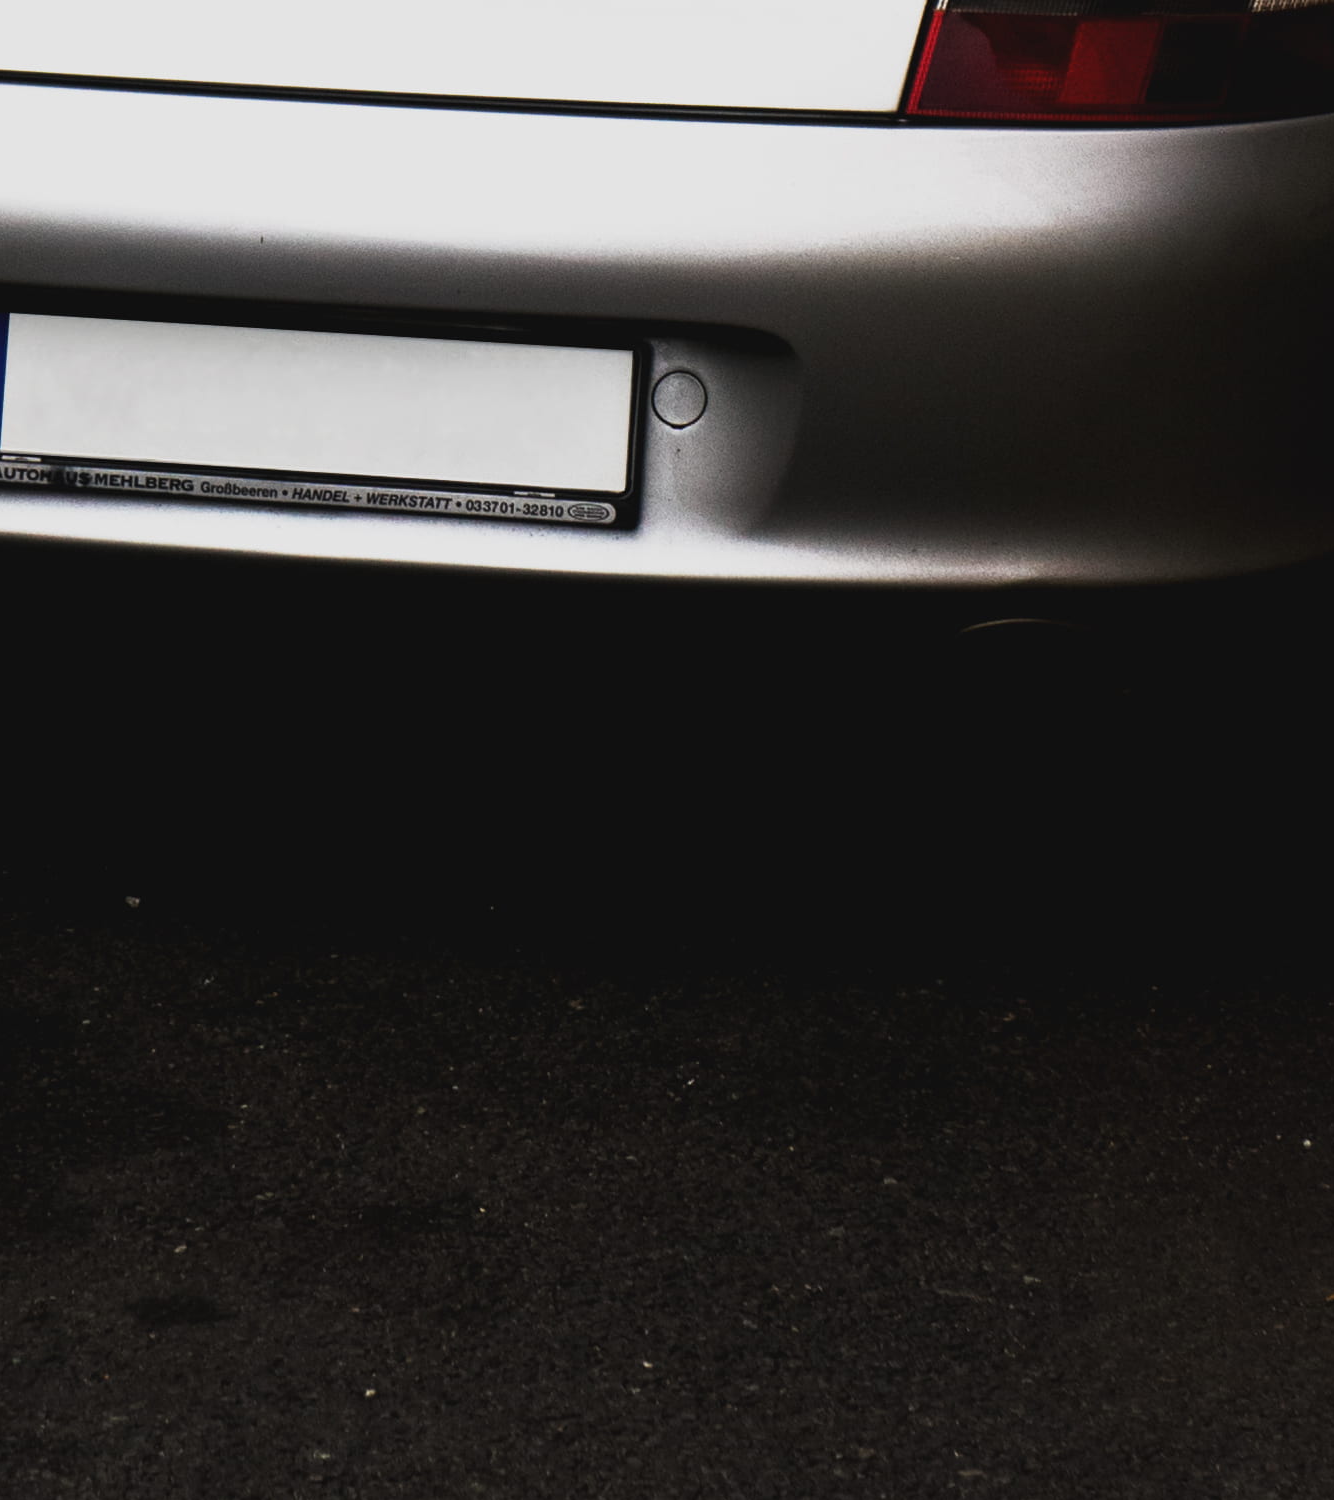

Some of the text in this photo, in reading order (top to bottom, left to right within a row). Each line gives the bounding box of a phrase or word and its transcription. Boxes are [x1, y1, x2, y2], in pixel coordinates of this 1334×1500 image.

[94, 472, 194, 492] MEHLBERG
[200, 481, 278, 499] Großbeeren
[292, 489, 350, 503] HANDEL
[367, 492, 452, 510] WERKSTATT
[466, 500, 564, 518] 033701-32810
